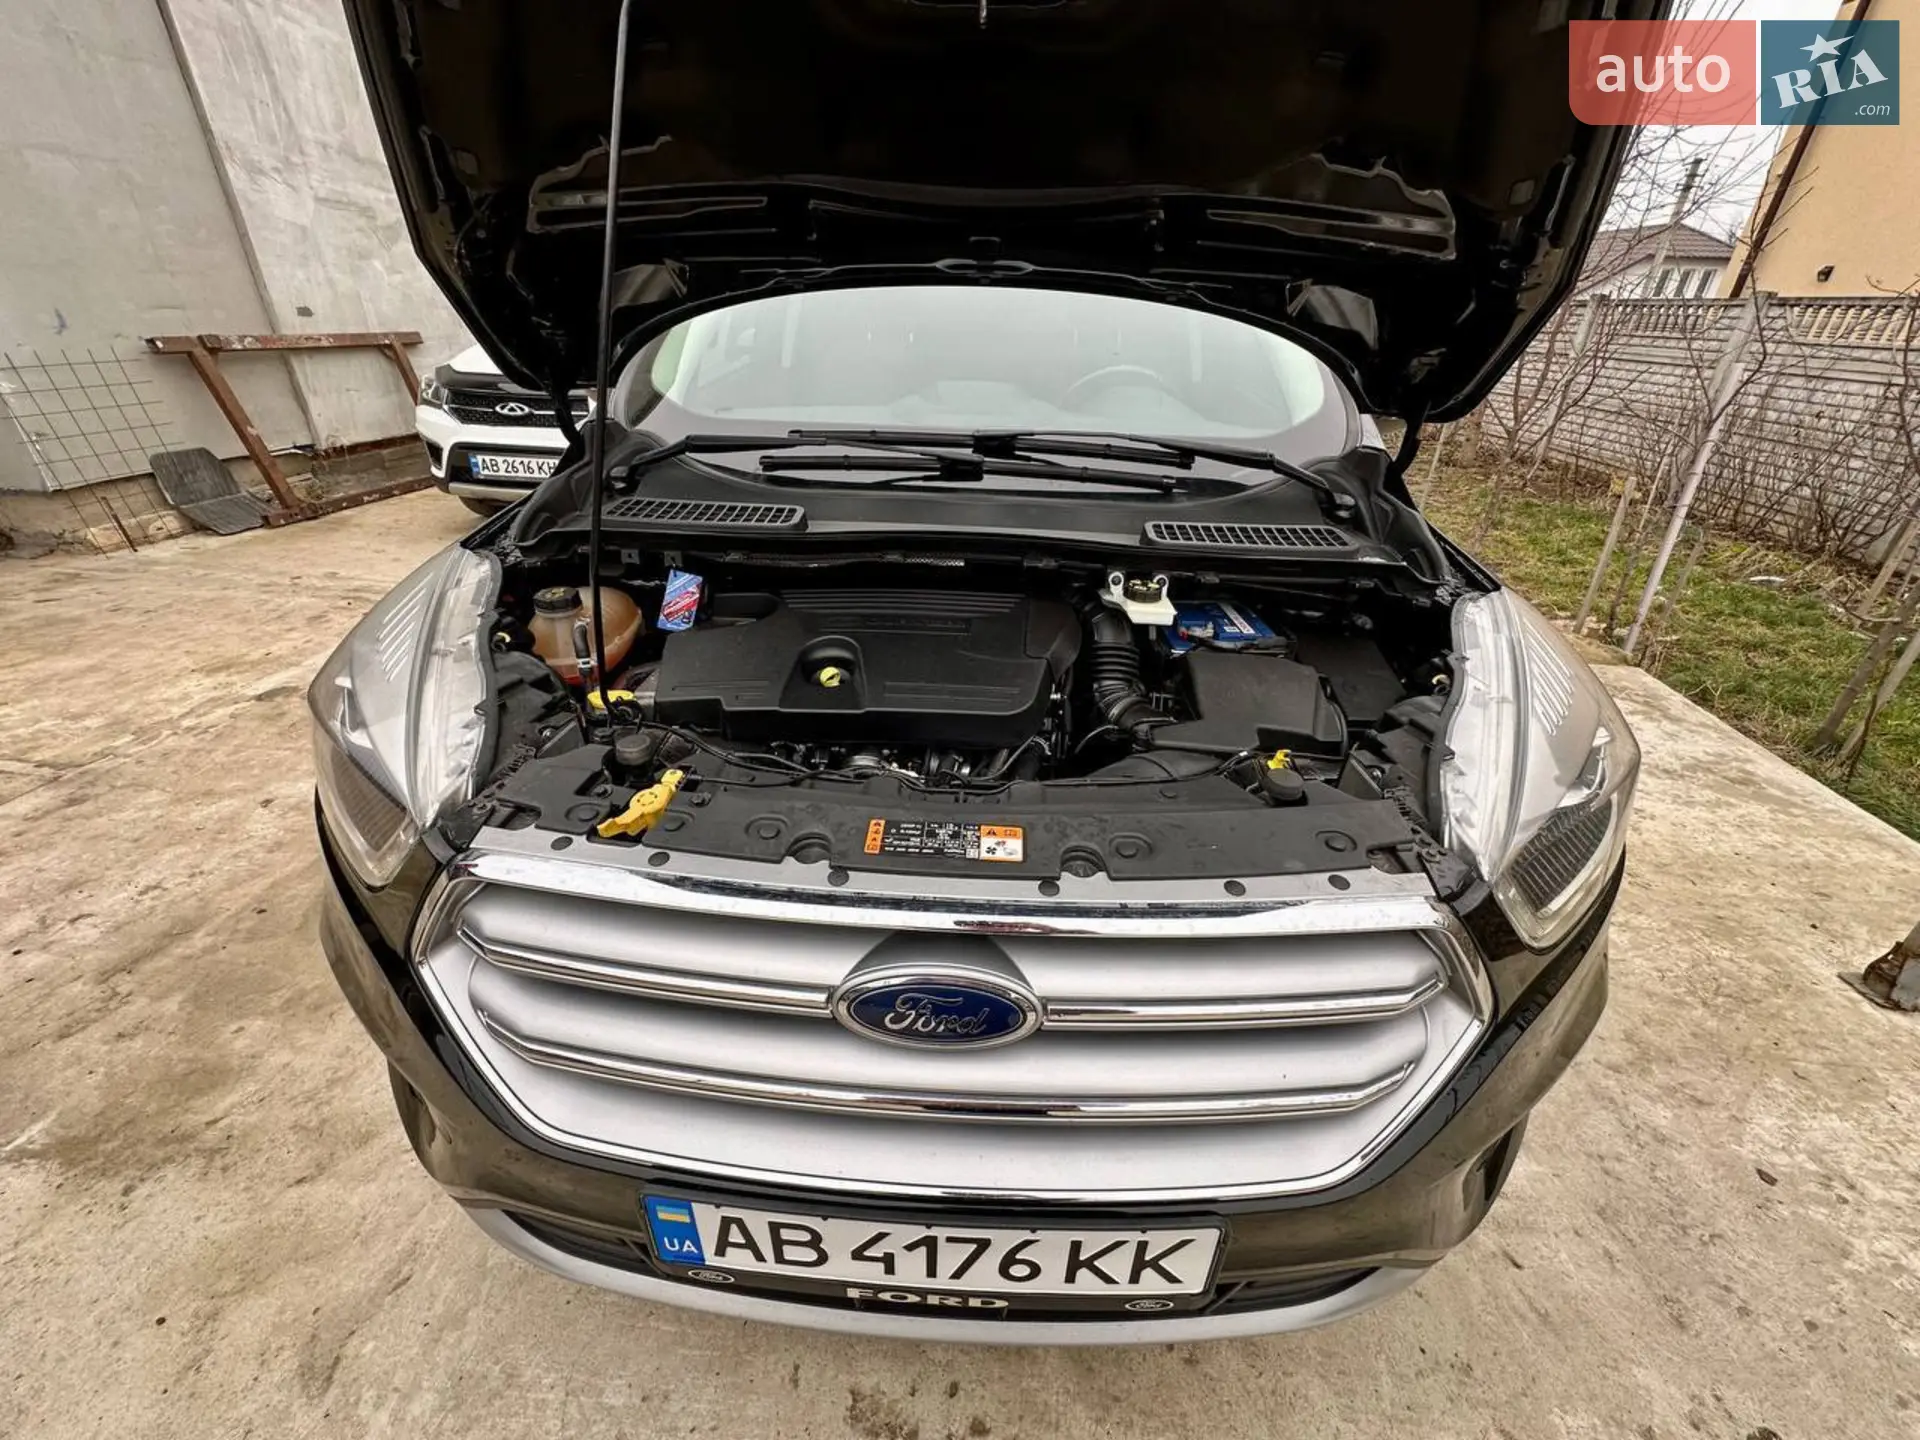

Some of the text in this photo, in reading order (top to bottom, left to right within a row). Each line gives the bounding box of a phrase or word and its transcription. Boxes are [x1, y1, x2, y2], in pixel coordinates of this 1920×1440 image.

[481, 457, 501, 473] AB
[502, 459, 535, 475] 2616
[883, 992, 990, 1034] Ford
[663, 1236, 698, 1254] UA
[713, 1215, 1197, 1285] AB 4176 KK
[846, 1287, 1009, 1309] FORD
